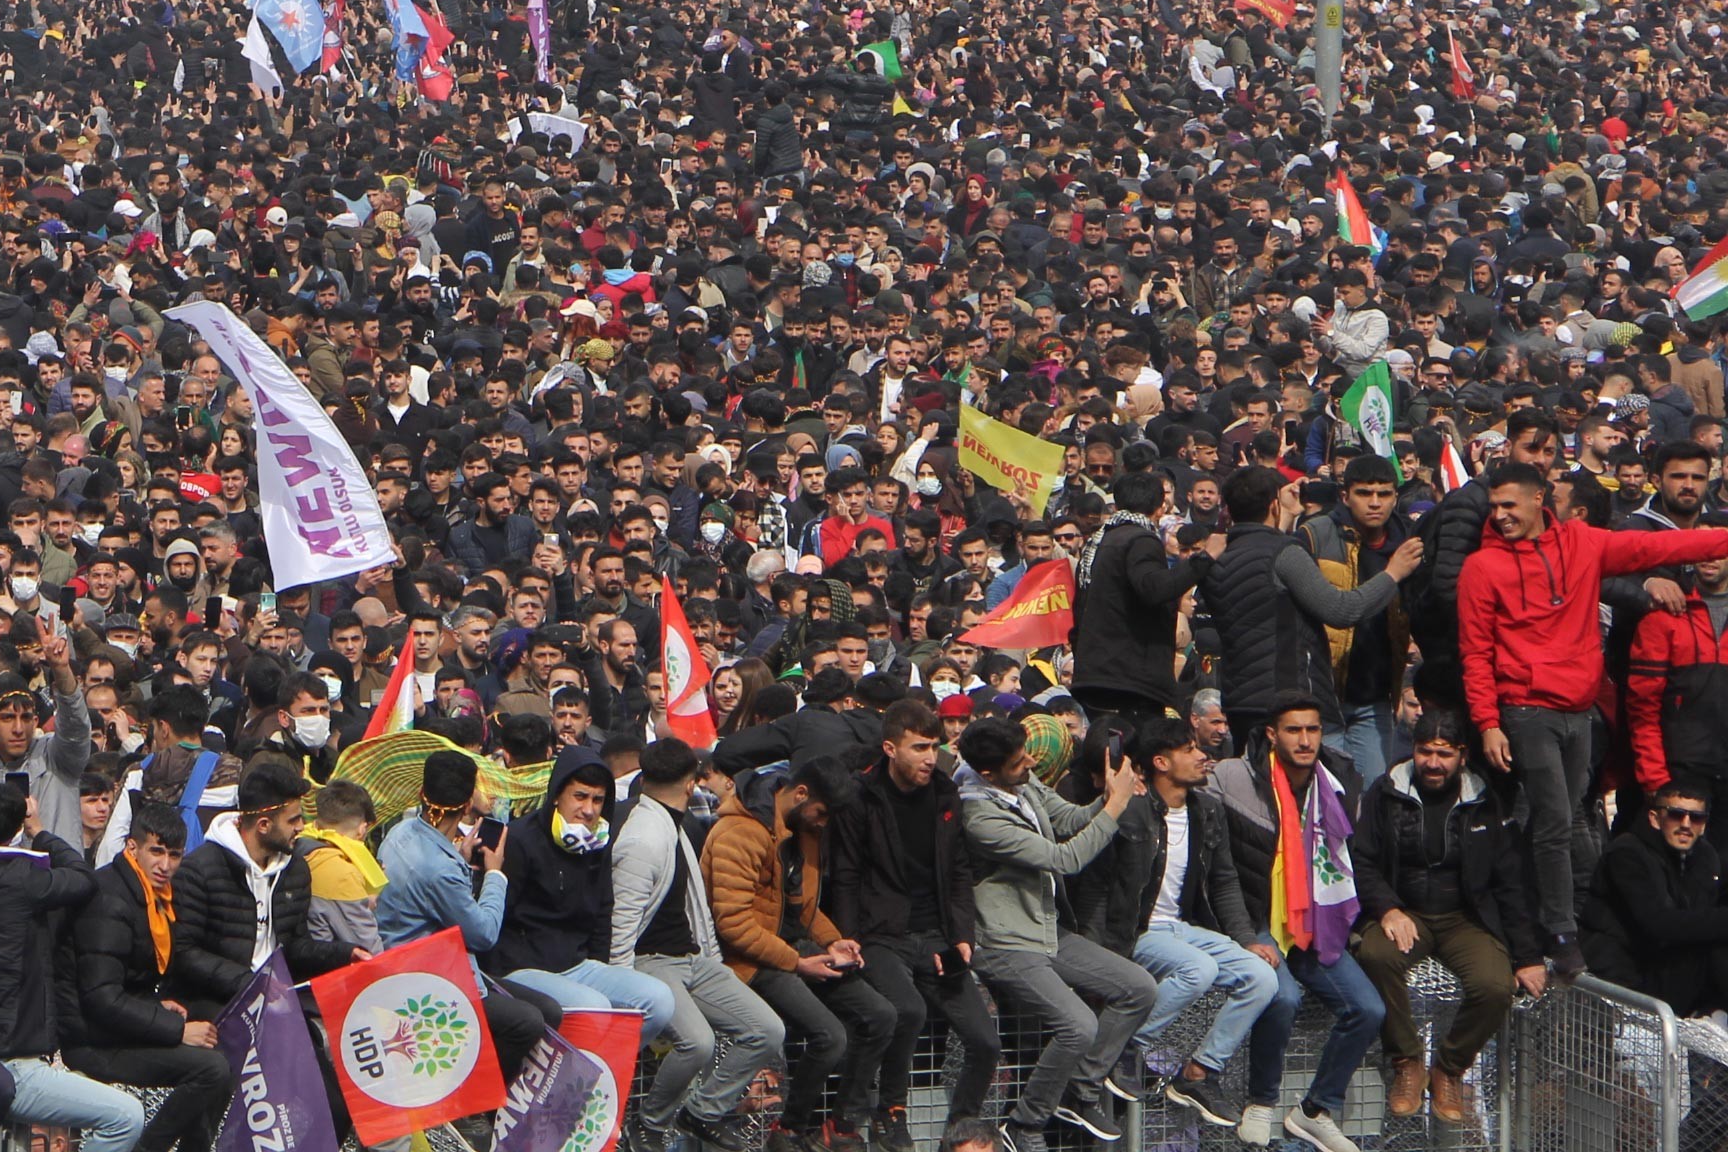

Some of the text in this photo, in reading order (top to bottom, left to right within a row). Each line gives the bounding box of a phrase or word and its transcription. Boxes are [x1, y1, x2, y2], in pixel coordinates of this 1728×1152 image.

[327, 466, 369, 554] KUTLU OLSUN
[349, 1026, 384, 1079] HDP
[286, 1132, 296, 1150] BE
